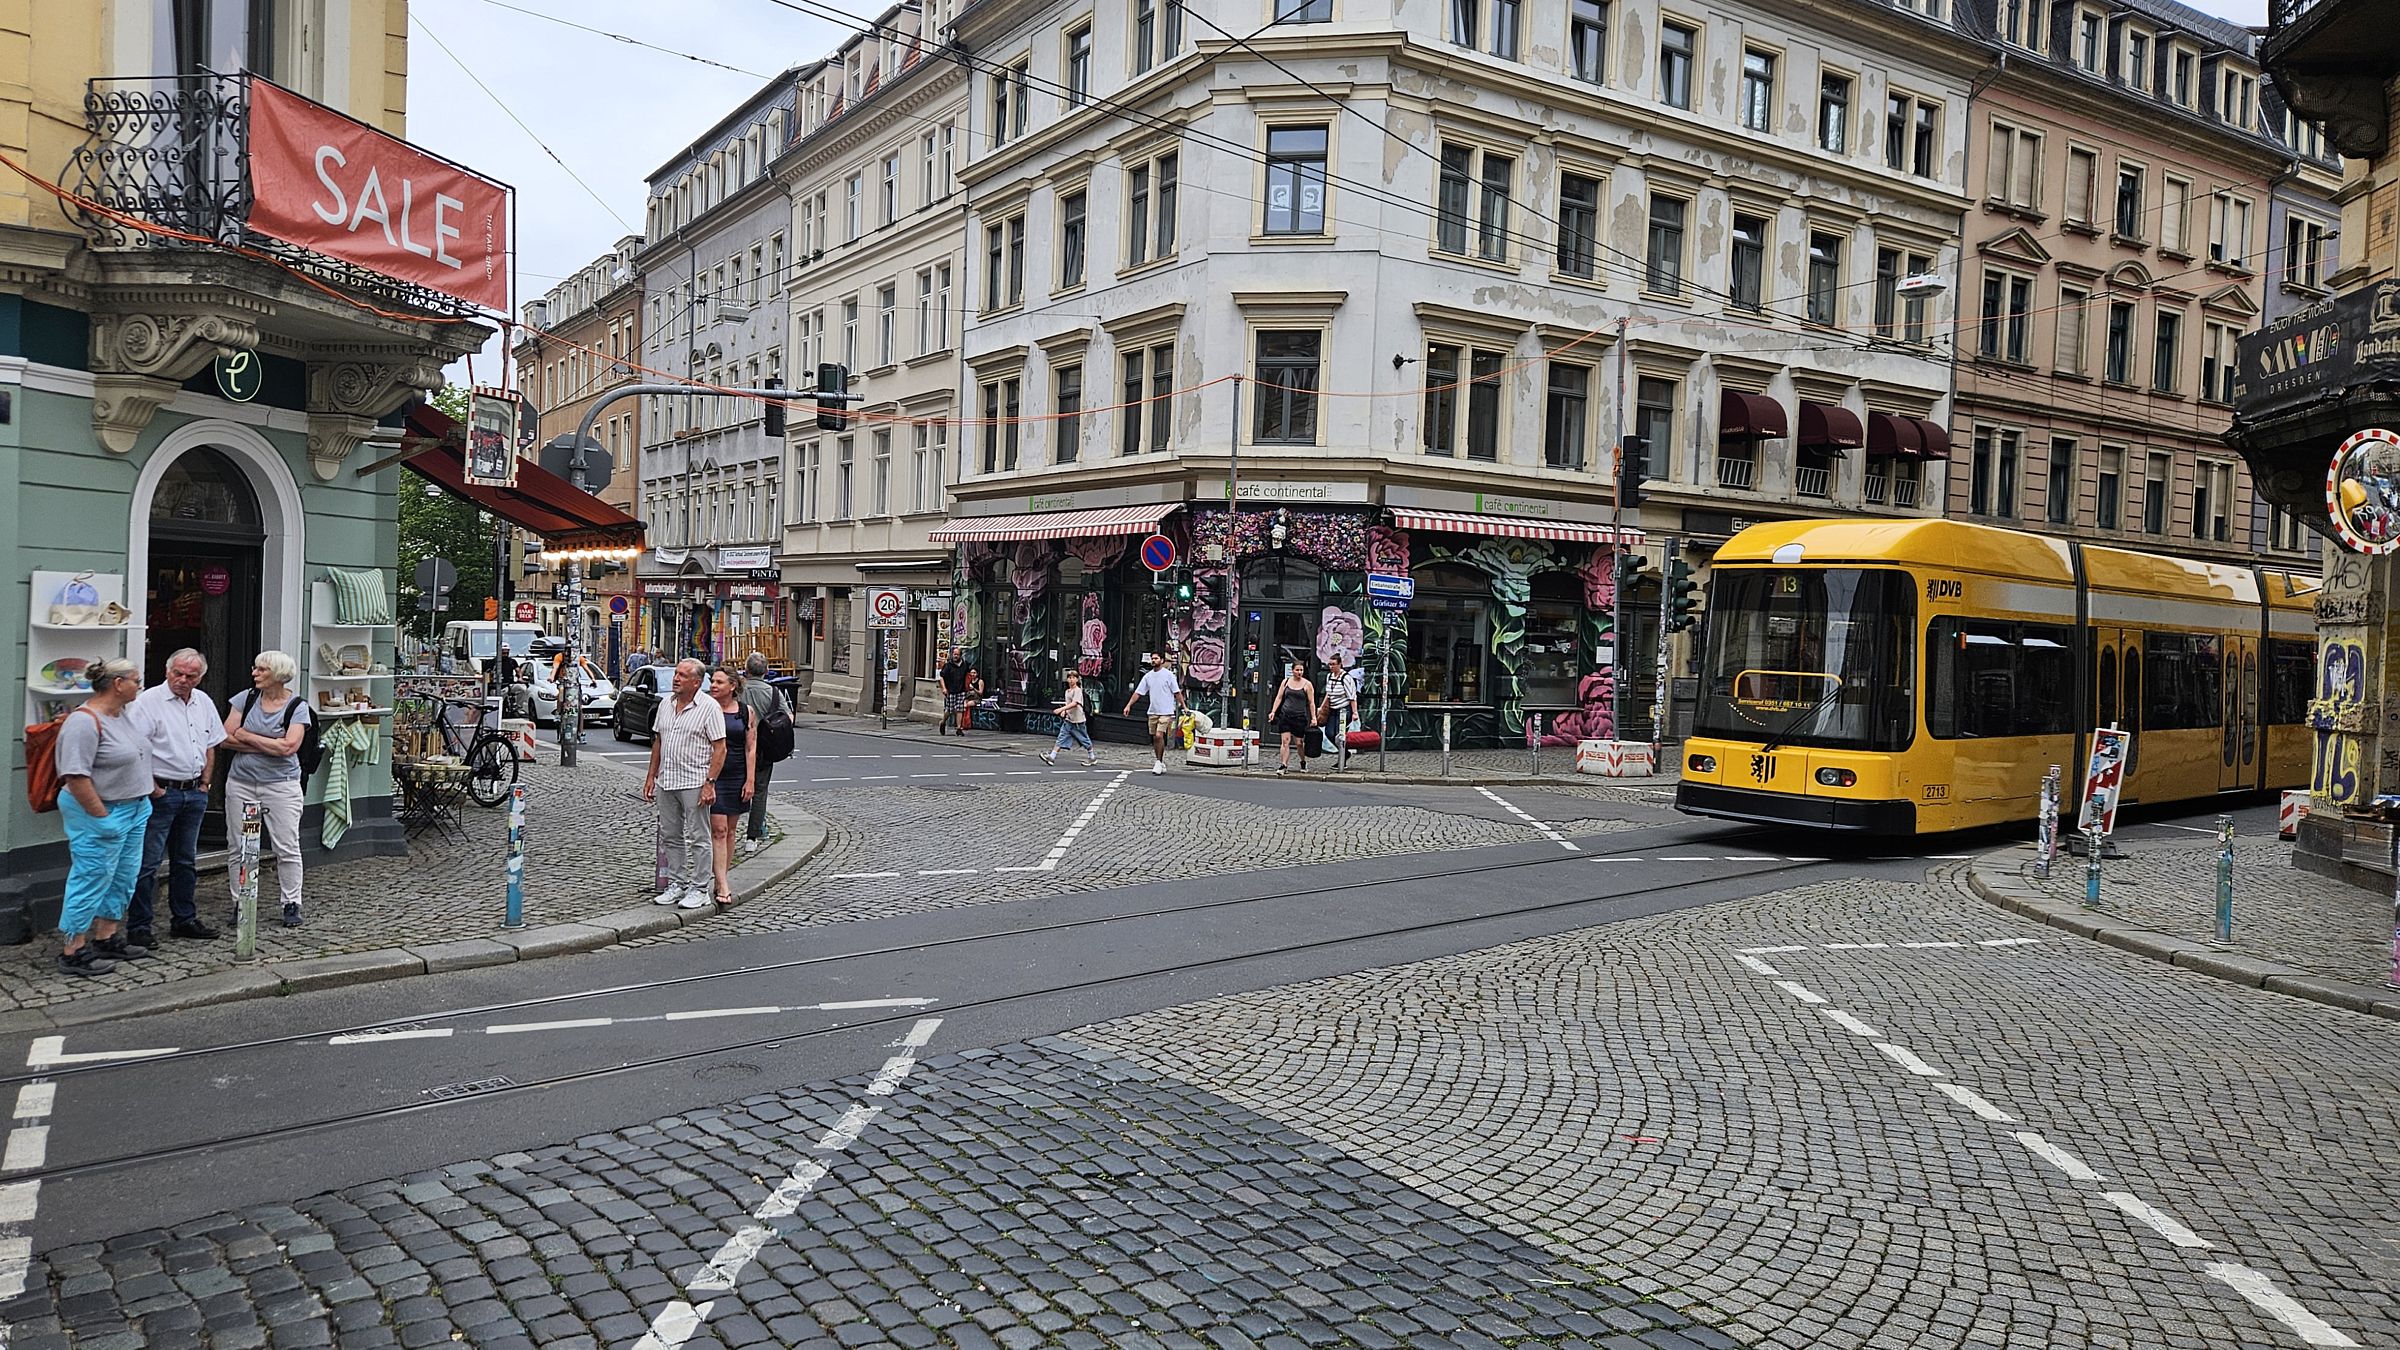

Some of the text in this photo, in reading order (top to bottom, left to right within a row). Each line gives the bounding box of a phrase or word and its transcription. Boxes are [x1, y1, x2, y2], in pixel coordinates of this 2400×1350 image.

[312, 145, 464, 270] SALE
[485, 255, 493, 281] SHOP
[2269, 299, 2335, 334] ENJOY THE WORLD
[2269, 370, 2321, 394] DRESDEN
[1236, 484, 1327, 498] café continental
[1484, 499, 1549, 515] café continental
[1782, 576, 1797, 593] 13
[1939, 579, 1962, 598] DVB
[880, 599, 895, 611] 20
[1373, 599, 1409, 608] Görlitzer Str.
[1926, 786, 1945, 798] 2713
